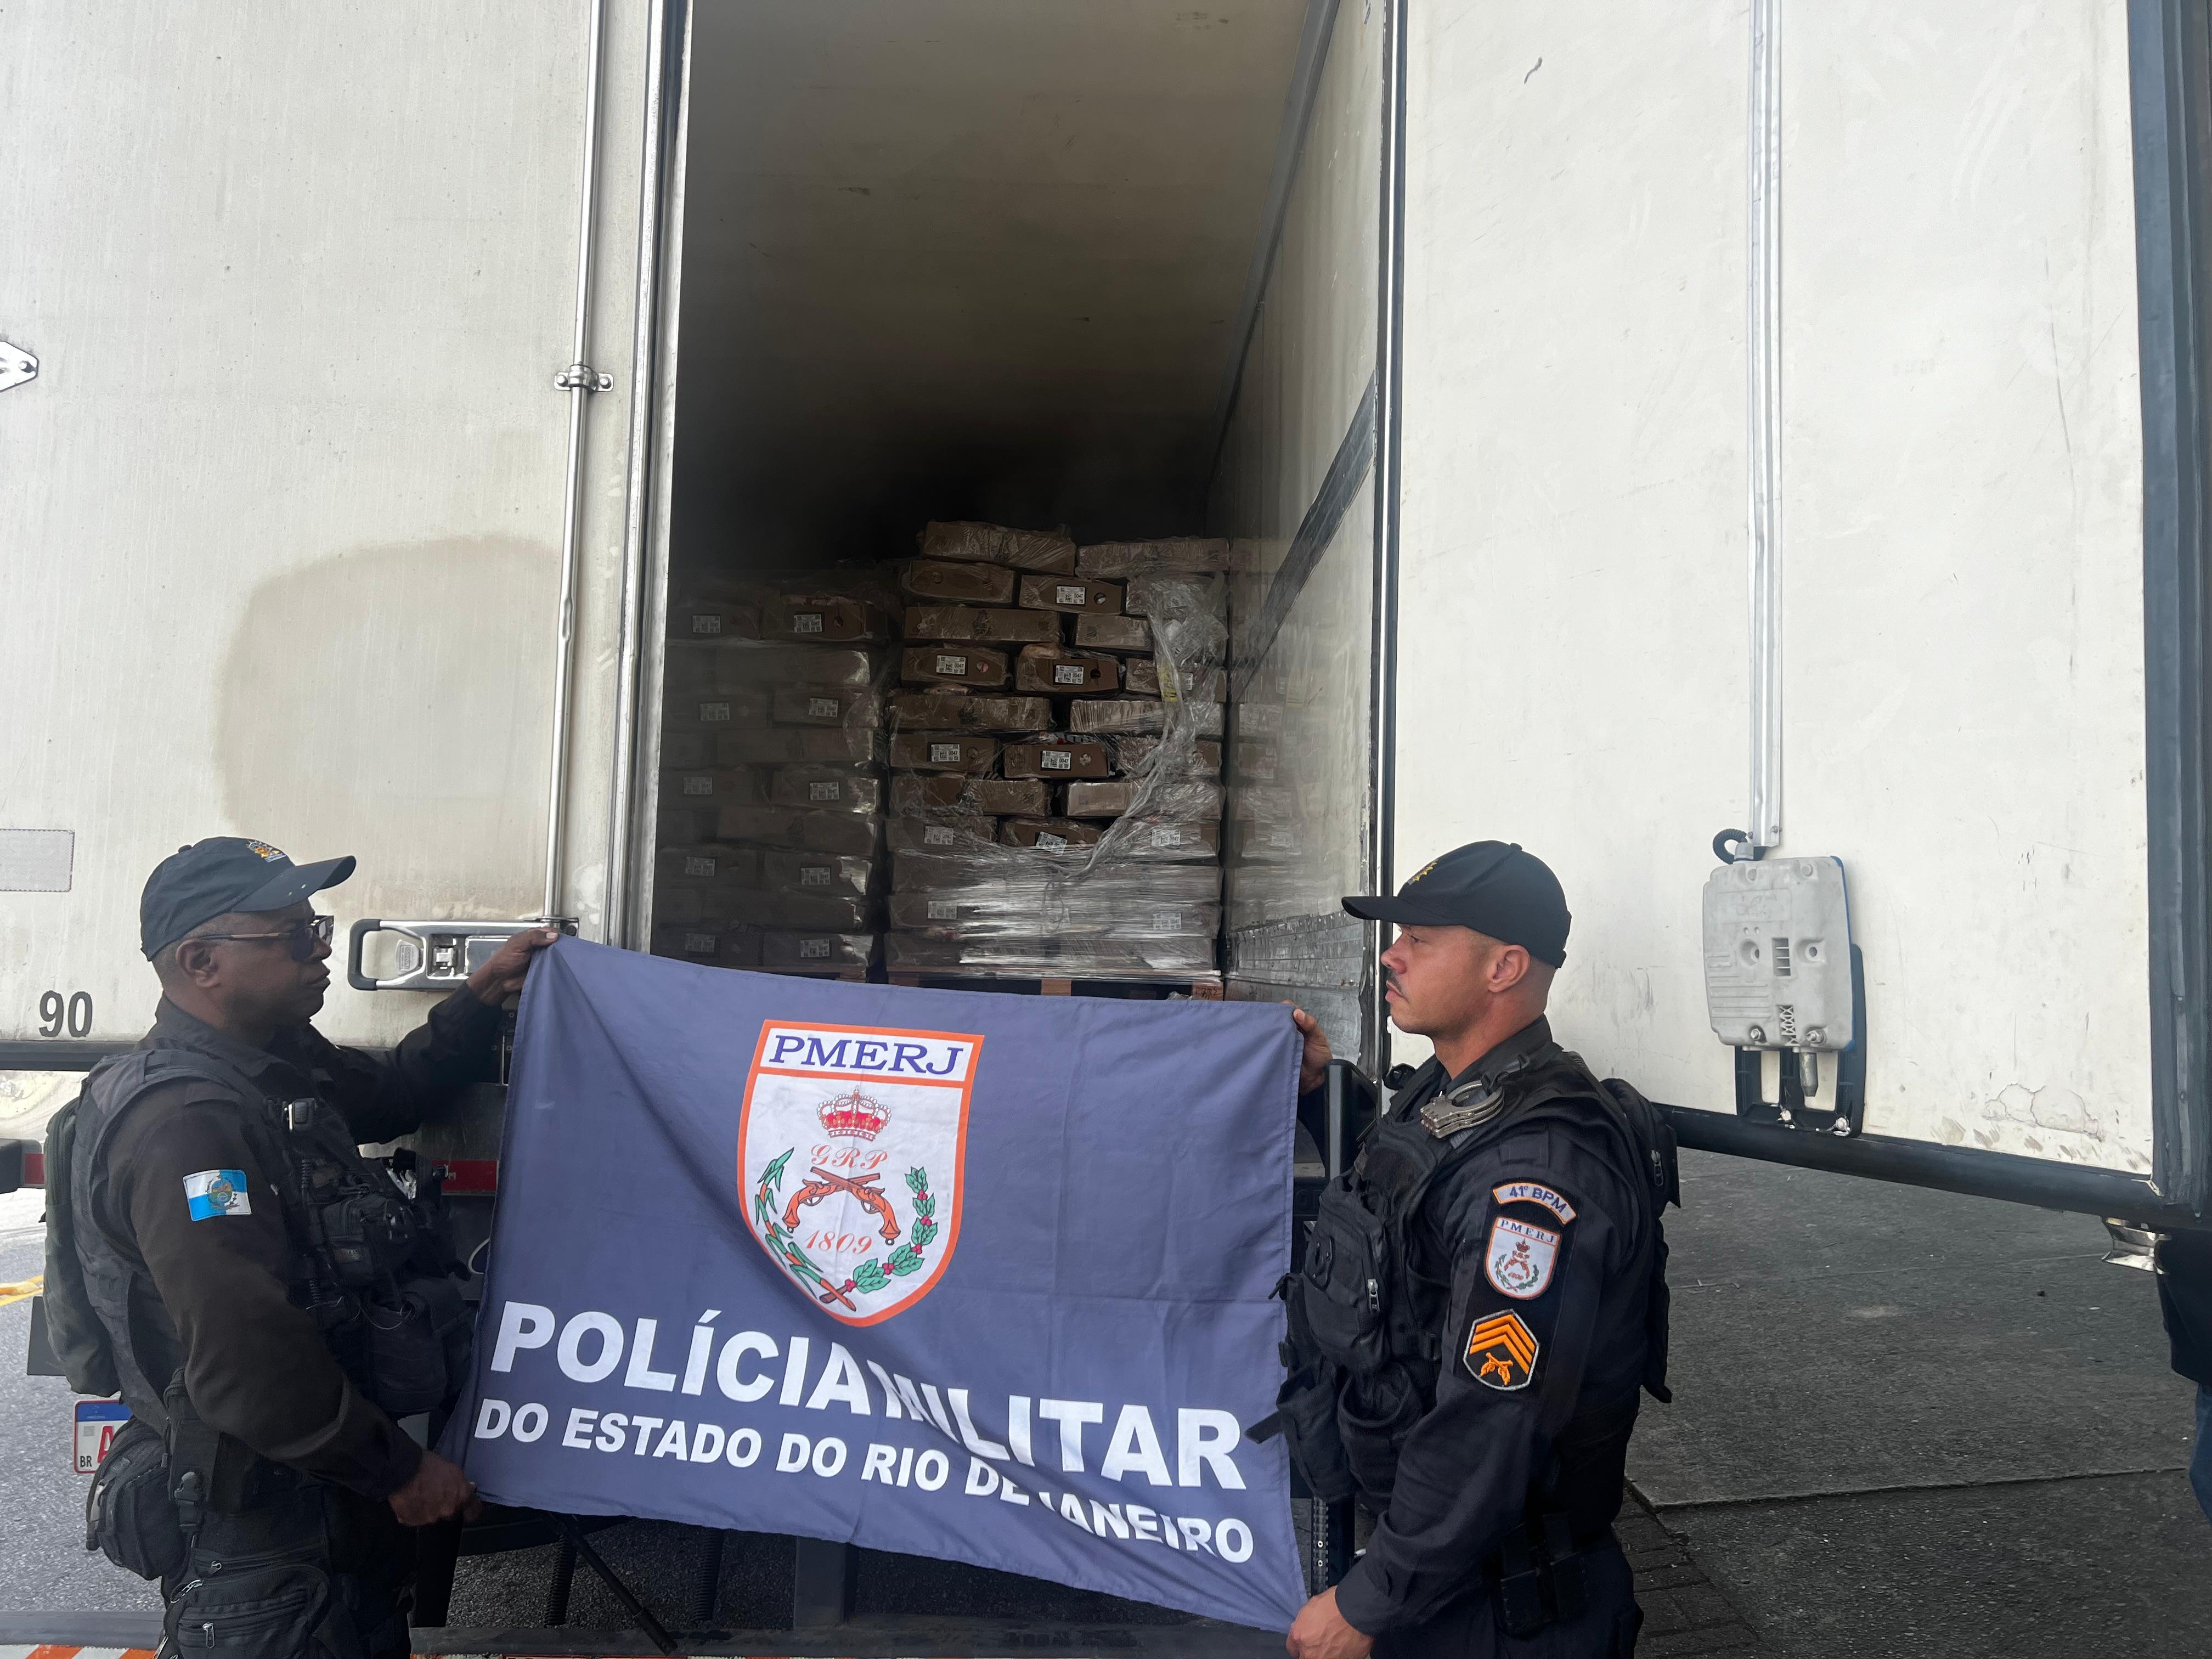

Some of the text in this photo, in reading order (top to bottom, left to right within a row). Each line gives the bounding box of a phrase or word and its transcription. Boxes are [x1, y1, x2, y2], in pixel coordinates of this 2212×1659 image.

[39, 990, 93, 1037] 90
[769, 1035, 964, 1075] PMERJ
[811, 1144, 888, 1170] GRP
[1532, 1187, 1567, 1213] BPM
[806, 1229, 872, 1255] 1809
[1500, 1219, 1555, 1243] PMERJ
[490, 1301, 1246, 1489] POLÍCIA MILITAR
[80, 1455, 92, 1468] BR
[474, 1398, 549, 1443] DO
[562, 1407, 762, 1468] ESTADO
[776, 1432, 847, 1477] DO
[861, 1443, 949, 1491] RIO
[964, 1456, 1029, 1506] DE
